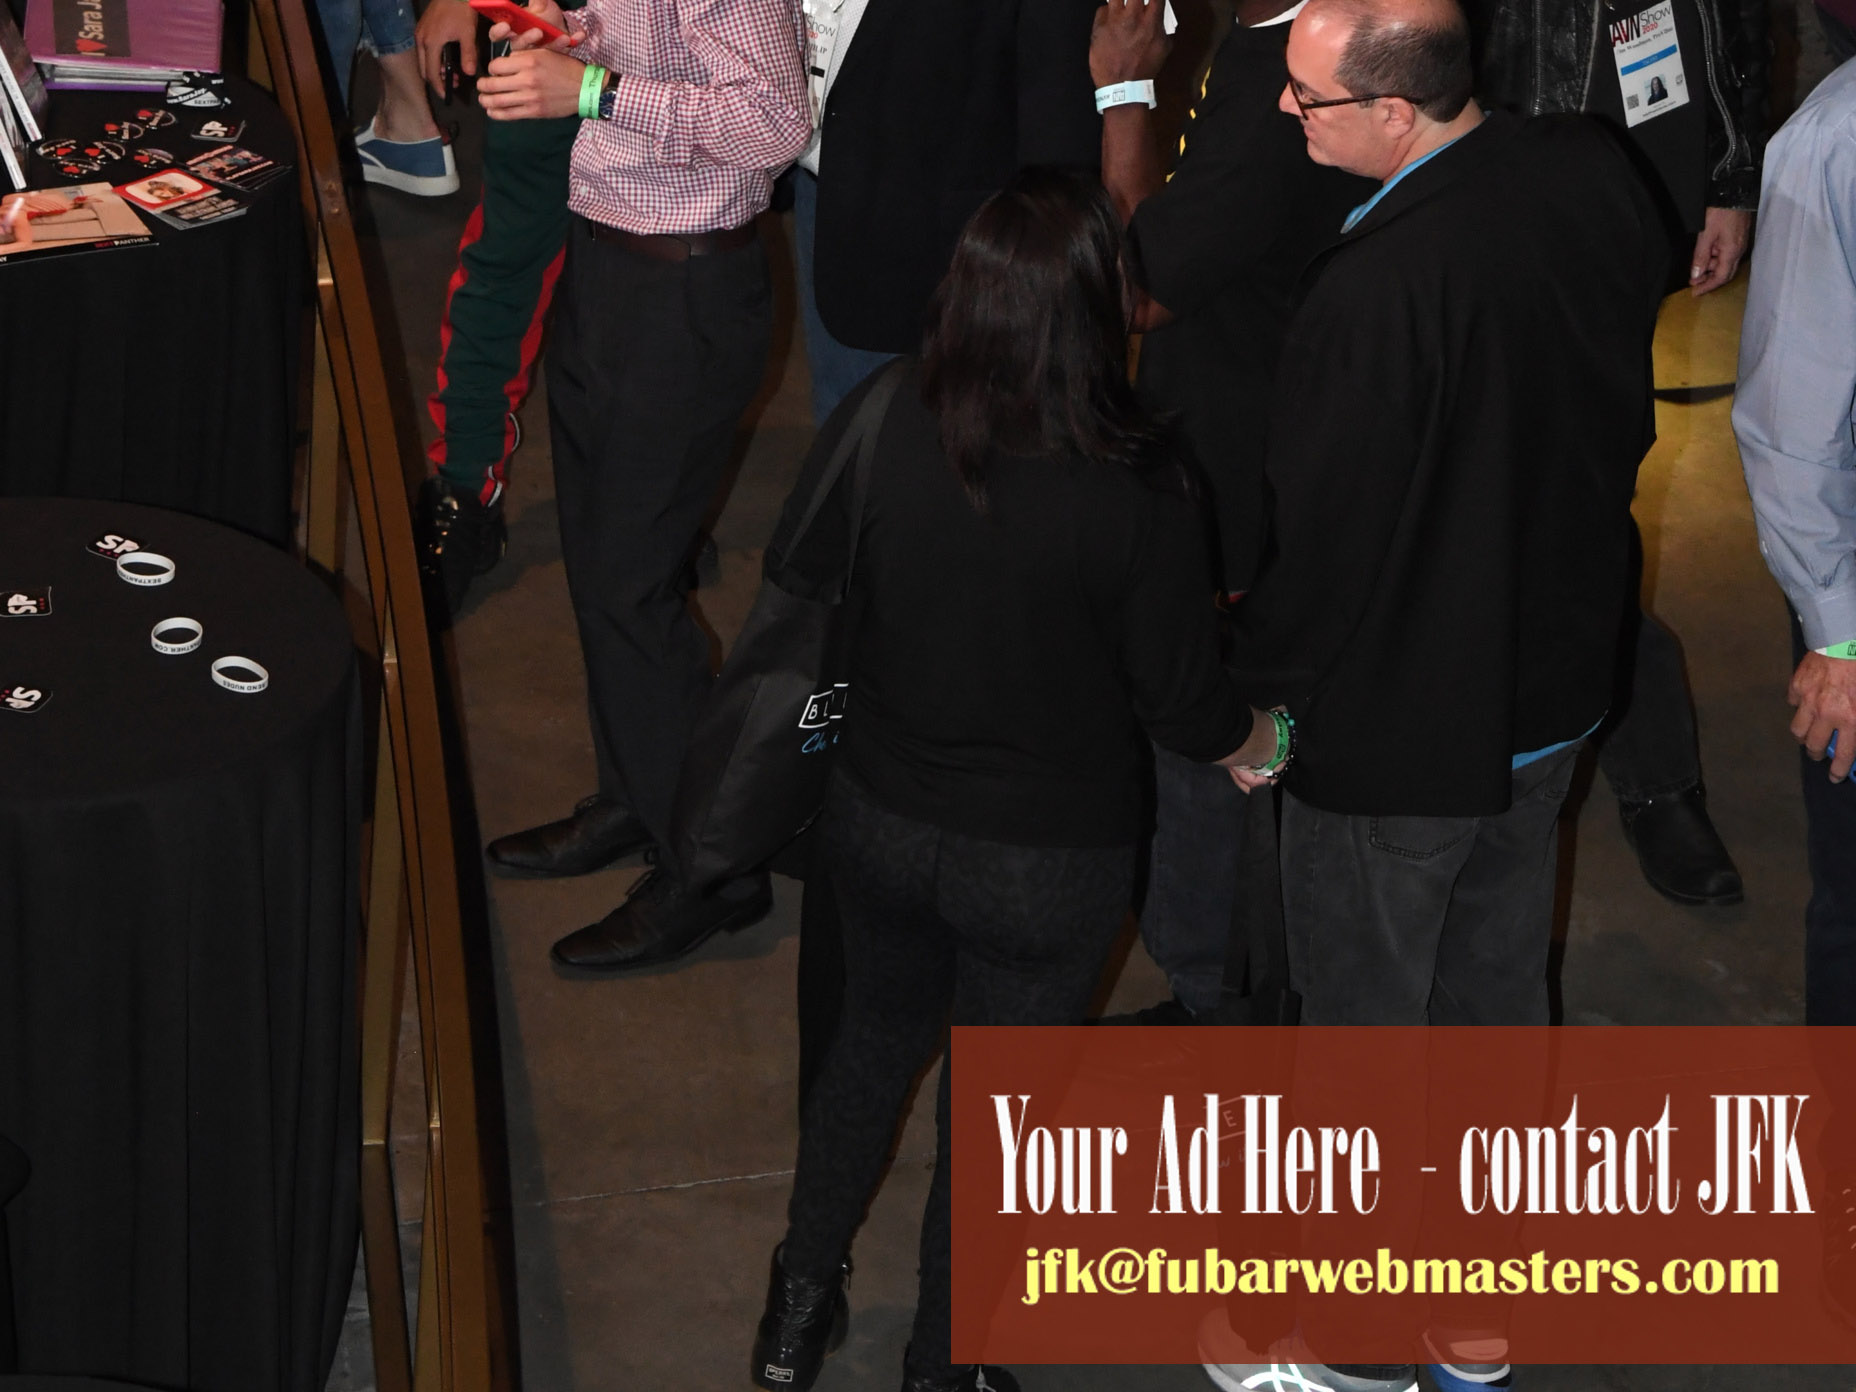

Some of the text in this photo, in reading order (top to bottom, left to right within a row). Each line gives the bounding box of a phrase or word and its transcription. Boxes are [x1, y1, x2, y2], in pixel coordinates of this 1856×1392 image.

[78, 10, 105, 40] Sara
[806, 13, 836, 37] Show
[1609, 11, 1641, 48] AVN
[1640, 6, 1672, 27] Show
